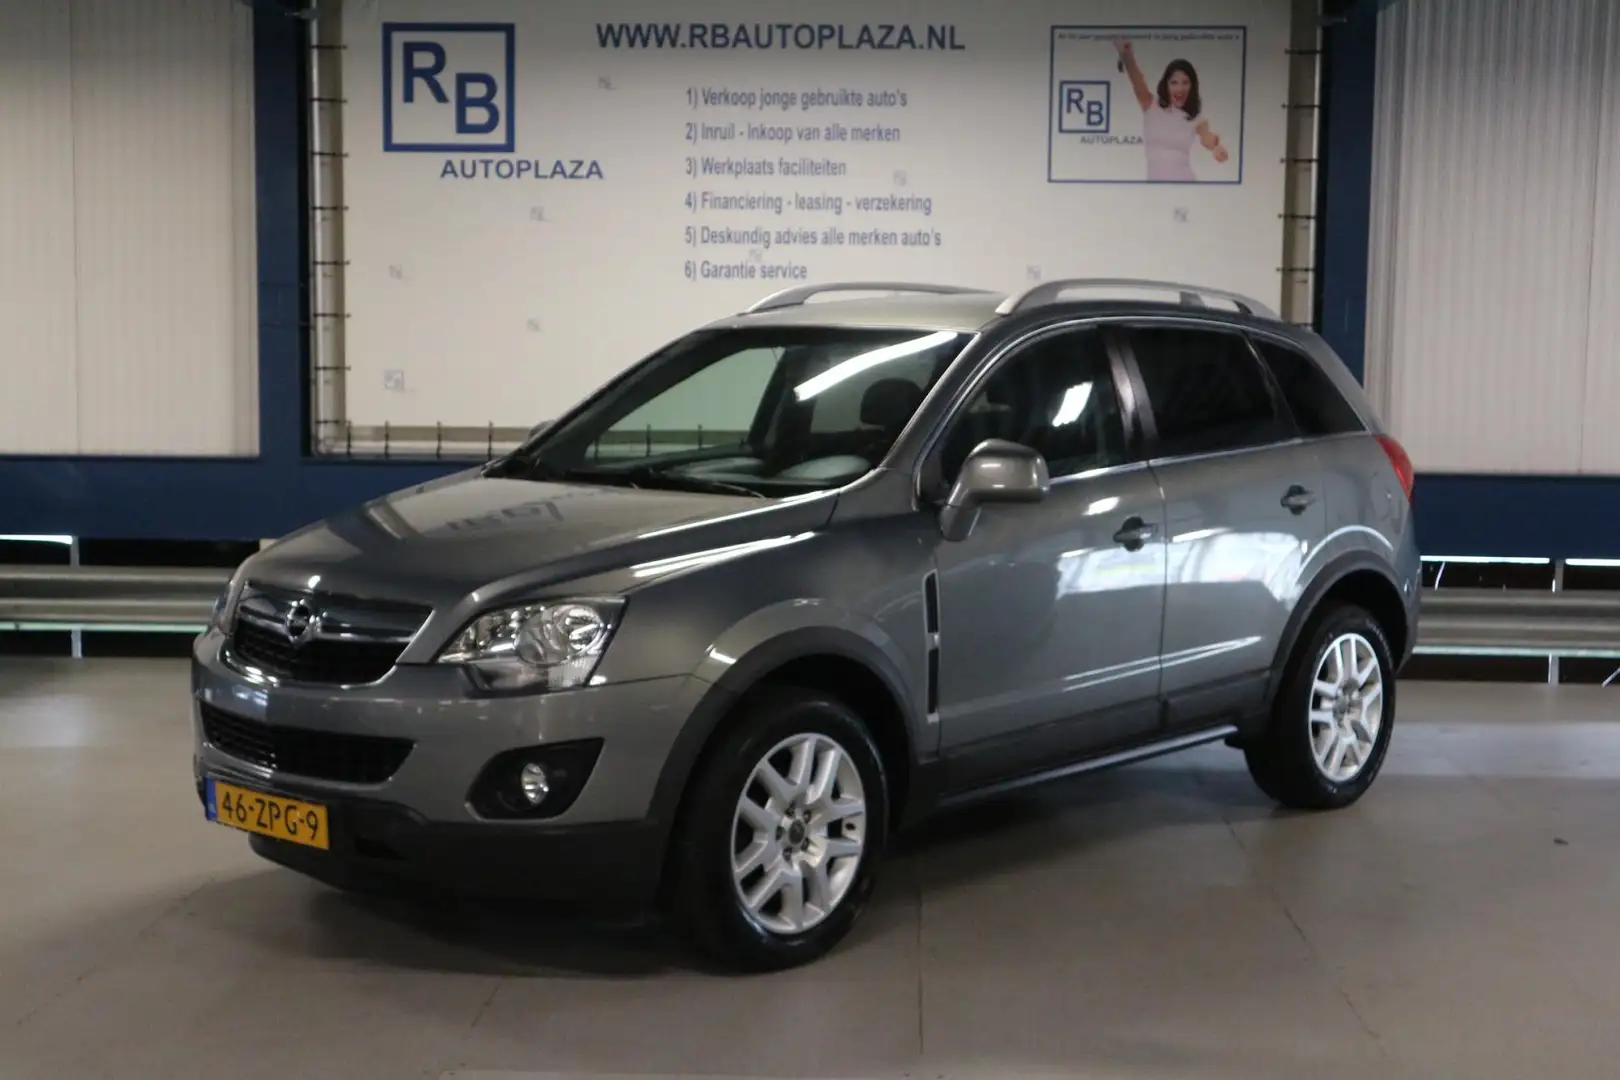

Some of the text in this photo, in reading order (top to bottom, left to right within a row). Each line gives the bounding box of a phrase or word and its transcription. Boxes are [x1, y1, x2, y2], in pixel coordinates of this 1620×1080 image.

[596, 23, 966, 51] WWW.RBAUTOPLAZA.NL
[402, 41, 500, 134] RB
[686, 87, 907, 111] 1) Verkoop jonge gebruikte auto's
[1066, 87, 1104, 126] RB
[685, 122, 697, 145] 2)
[701, 122, 735, 141] Inruil
[747, 122, 793, 143] Inkoop
[797, 126, 821, 141] van
[824, 123, 847, 141] alle
[850, 123, 901, 141] merken
[1080, 134, 1144, 145] AUTOPLAZA
[440, 159, 603, 180] AUTOPLAZA
[685, 156, 846, 178] 3) Werkplaats faciliteiten
[684, 191, 697, 213] 4)
[701, 190, 783, 215] Financiering
[794, 191, 842, 215] leasing
[855, 193, 932, 216] verzekering
[684, 225, 942, 249] 5) Deskundig advies alle merken auto's
[684, 259, 808, 282] 6) Garantie service
[222, 791, 319, 840] 46-ZPG-9
